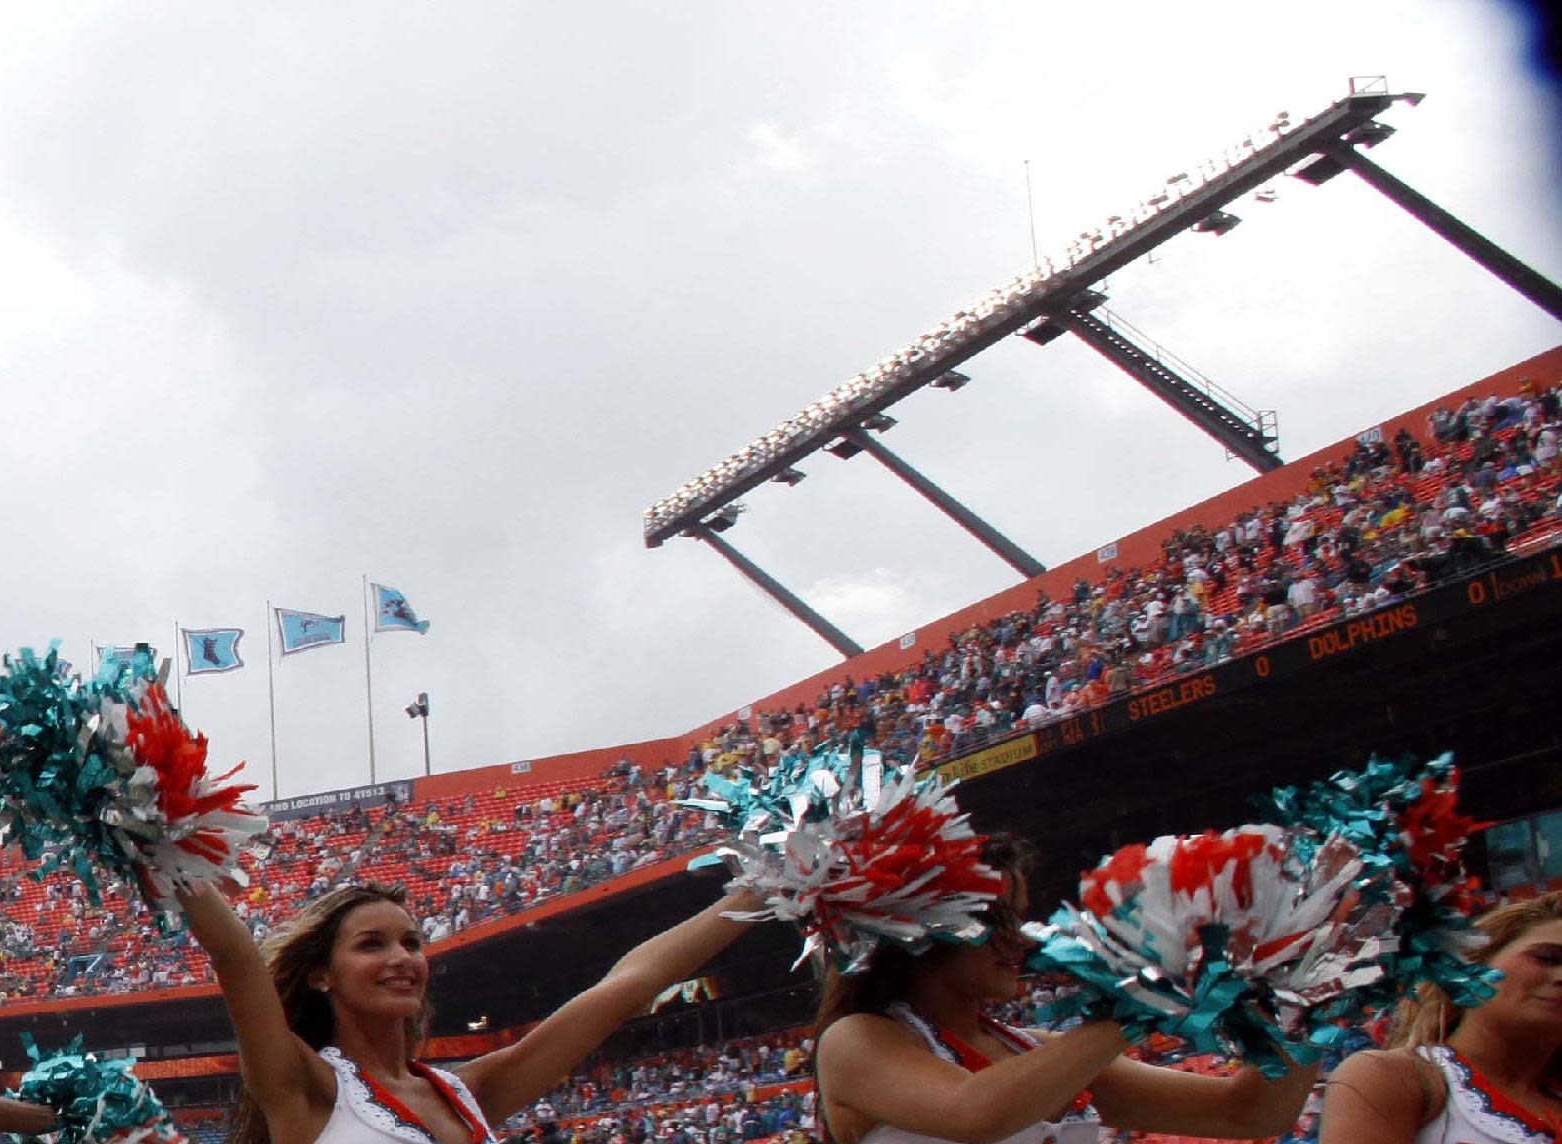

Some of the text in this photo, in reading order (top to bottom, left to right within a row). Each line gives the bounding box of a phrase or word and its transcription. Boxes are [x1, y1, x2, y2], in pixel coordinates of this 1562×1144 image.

[1468, 581, 1485, 605] 0
[1308, 603, 1419, 660] DOLPHINS
[1255, 656, 1271, 677] 0
[1128, 675, 1217, 721] STEELERS
[952, 759, 977, 782] Life
[981, 744, 1035, 770] STADIUM
[291, 793, 336, 810] LOCATION
[339, 791, 351, 801] TO
